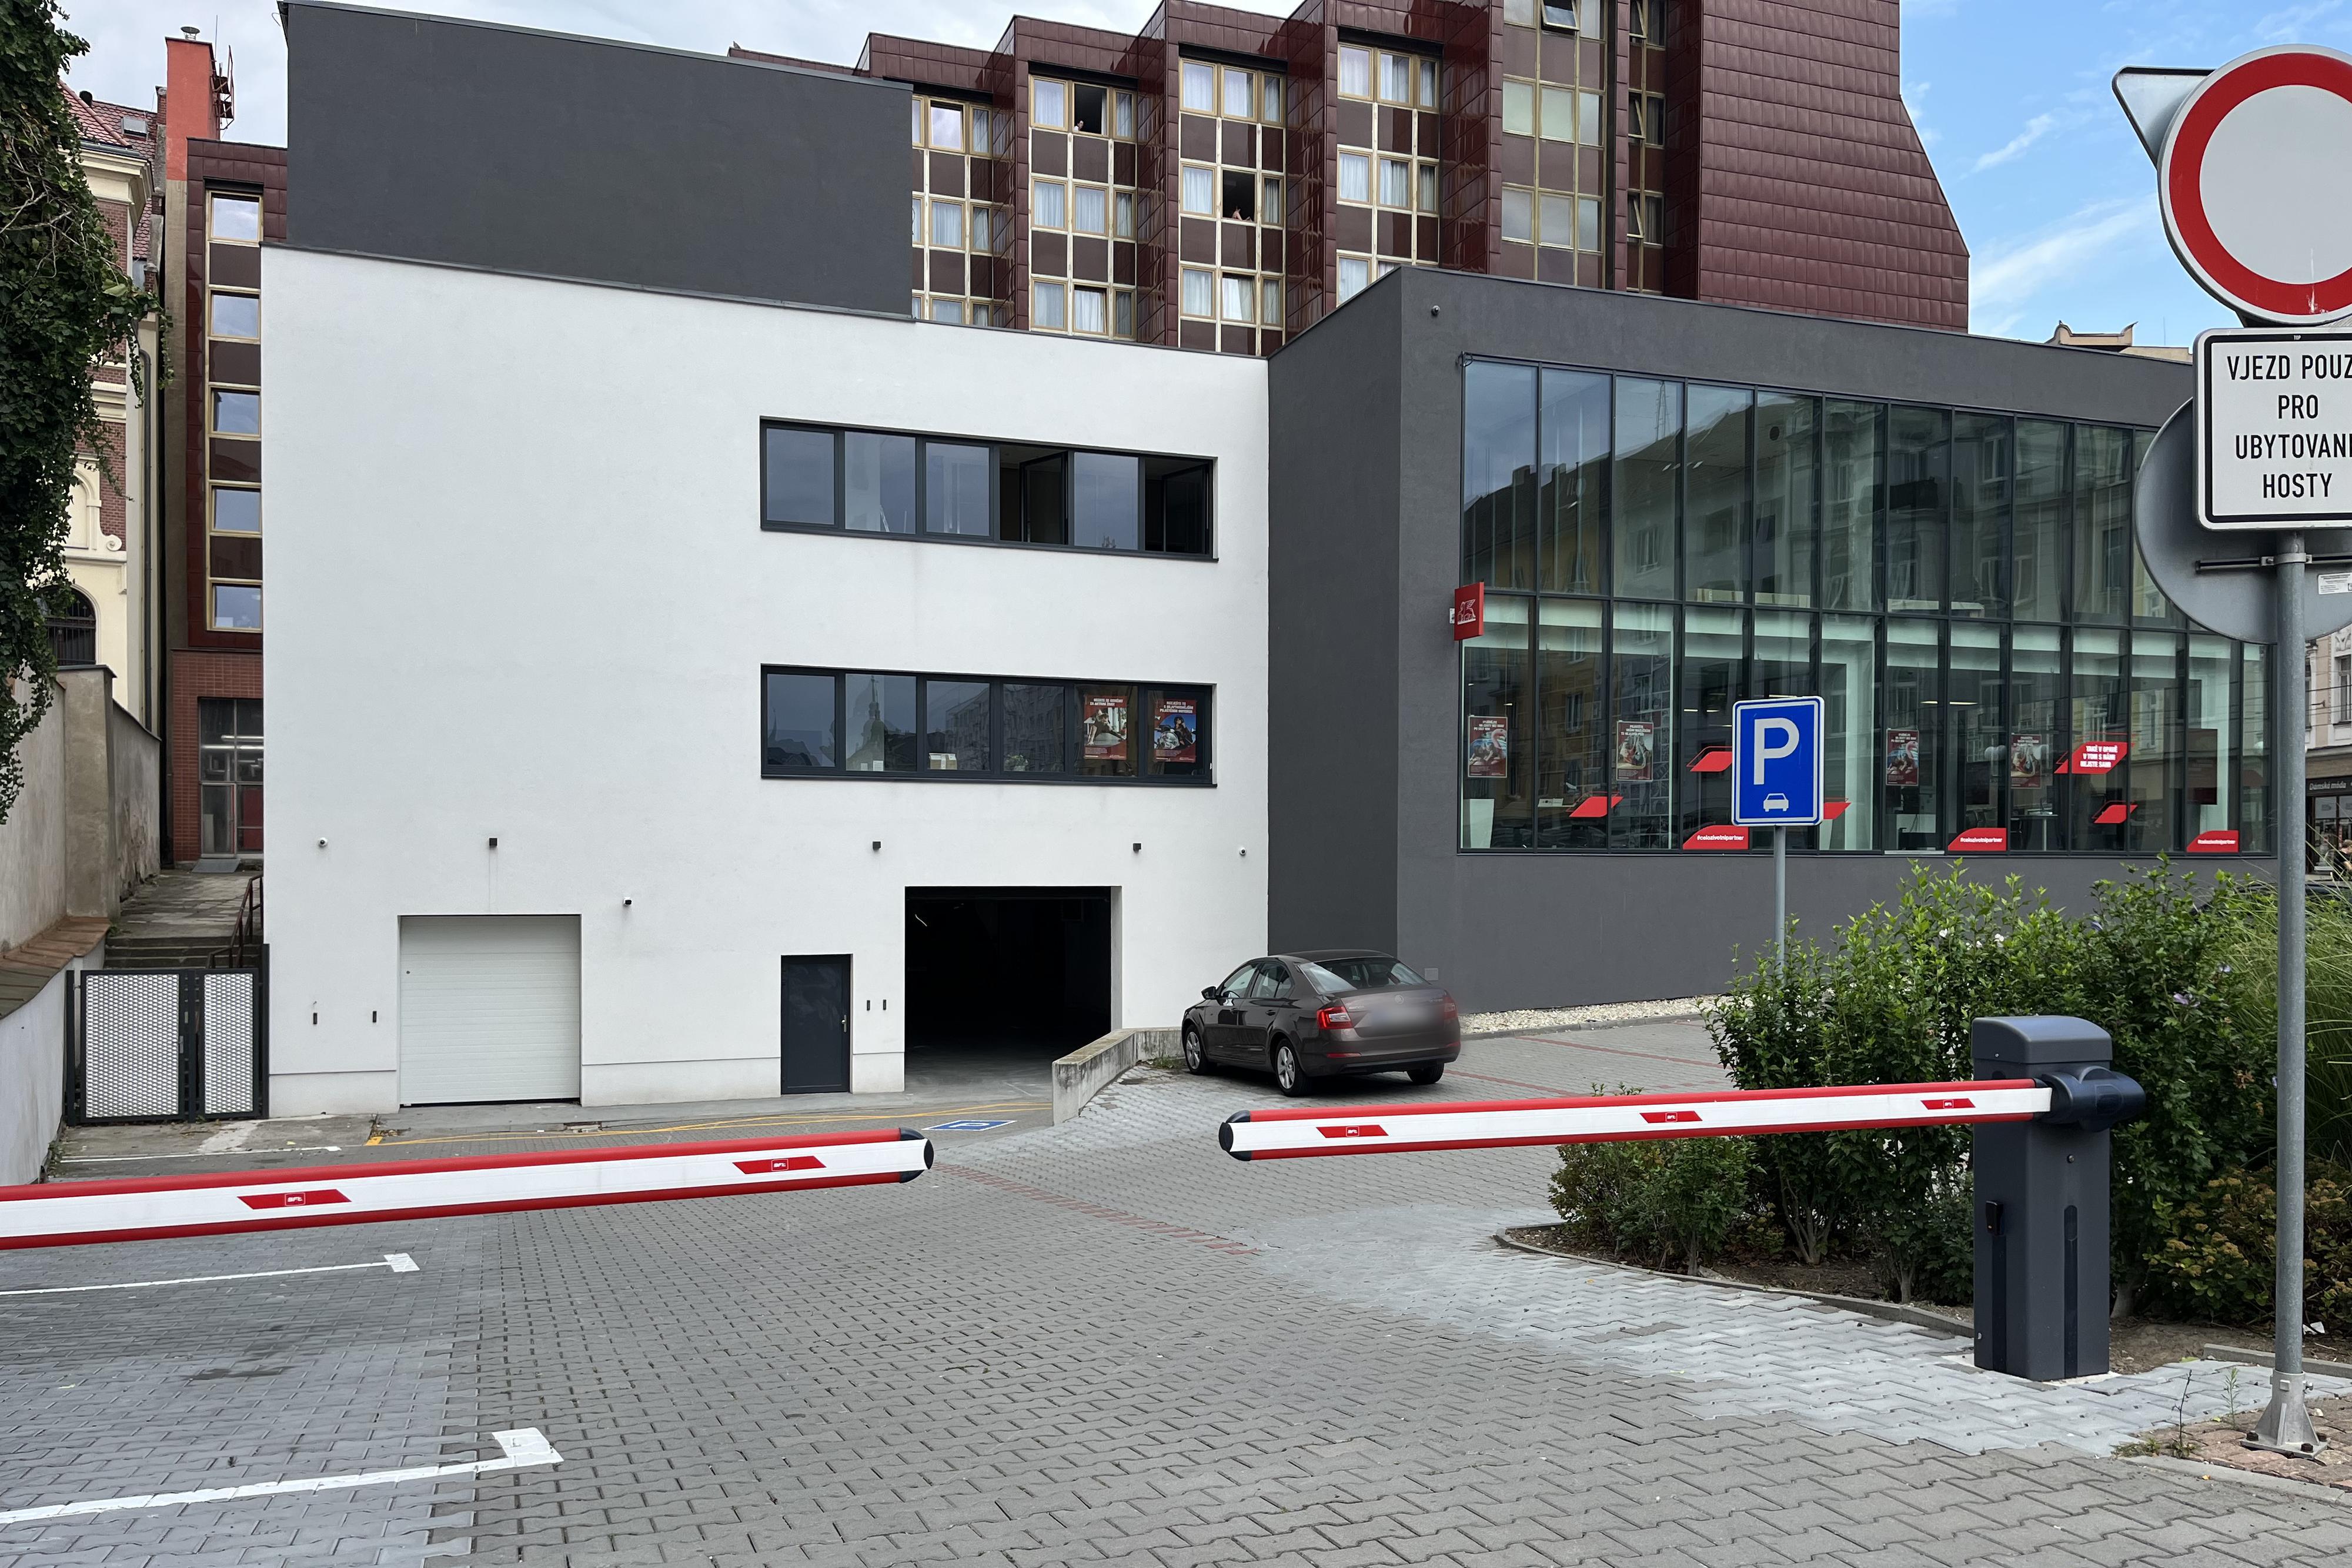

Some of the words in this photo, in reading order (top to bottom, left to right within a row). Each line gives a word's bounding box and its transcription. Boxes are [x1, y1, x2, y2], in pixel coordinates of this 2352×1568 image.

[2227, 355, 2290, 380] VJEZD
[2302, 355, 2352, 379] POUZ
[2278, 394, 2318, 419] PRO
[2236, 433, 2352, 459] UBYTOVAN
[2263, 473, 2333, 499] HOSTY
[1753, 717, 1800, 785] P
